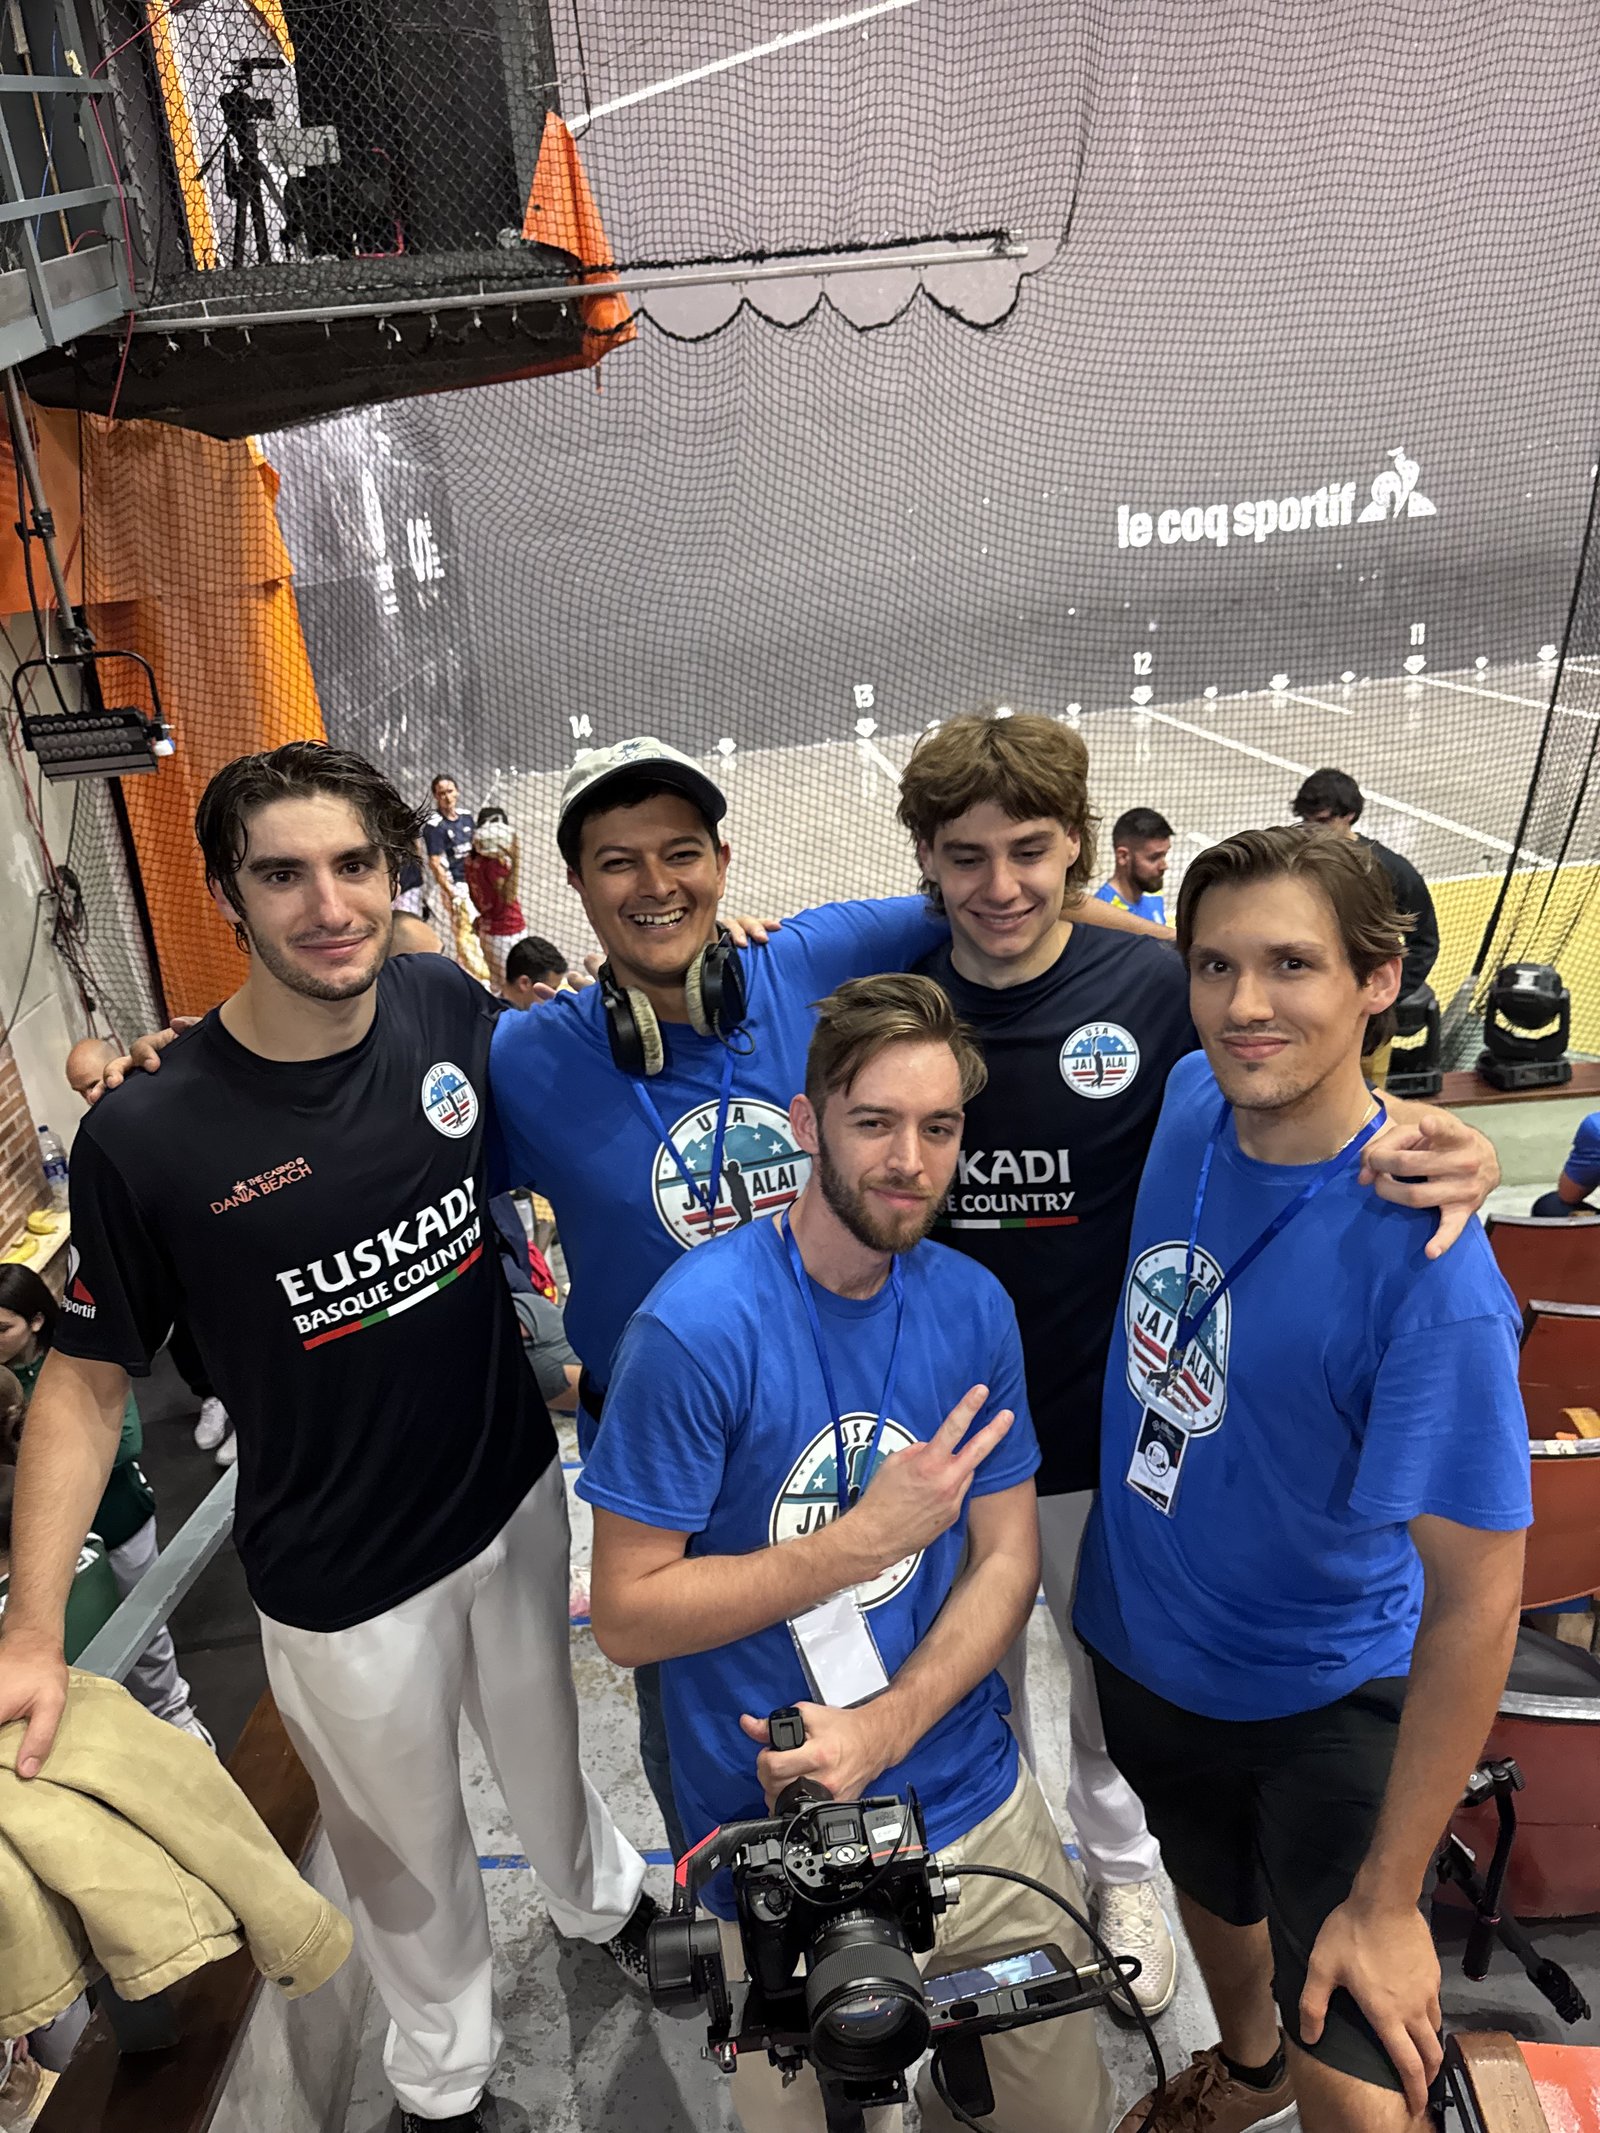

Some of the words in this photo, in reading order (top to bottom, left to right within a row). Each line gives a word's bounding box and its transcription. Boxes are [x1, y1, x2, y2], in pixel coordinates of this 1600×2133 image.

[1117, 504, 1153, 548] le
[1158, 503, 1228, 547] coq
[1232, 481, 1356, 543] sportif
[1409, 622, 1426, 646] 11
[1132, 651, 1152, 675] 12
[852, 684, 875, 709] 13
[1085, 1026, 1109, 1037] USA
[1072, 1058, 1092, 1070] JAI
[1105, 1056, 1127, 1068] ALAI
[437, 1100, 452, 1118] JAI
[696, 1106, 746, 1132] UA
[247, 1174, 264, 1186] THE
[259, 1163, 313, 1196] BEACH
[957, 1149, 1072, 1186] KADI
[752, 1164, 798, 1197] ALAI
[960, 1191, 1076, 1213] COUNTRY
[275, 1175, 478, 1307] EUSKADI
[292, 1280, 393, 1335] BASQUE
[393, 1216, 481, 1293] COUNTRY
[1137, 1301, 1174, 1347] JAI
[1186, 1344, 1216, 1395] ALAI
